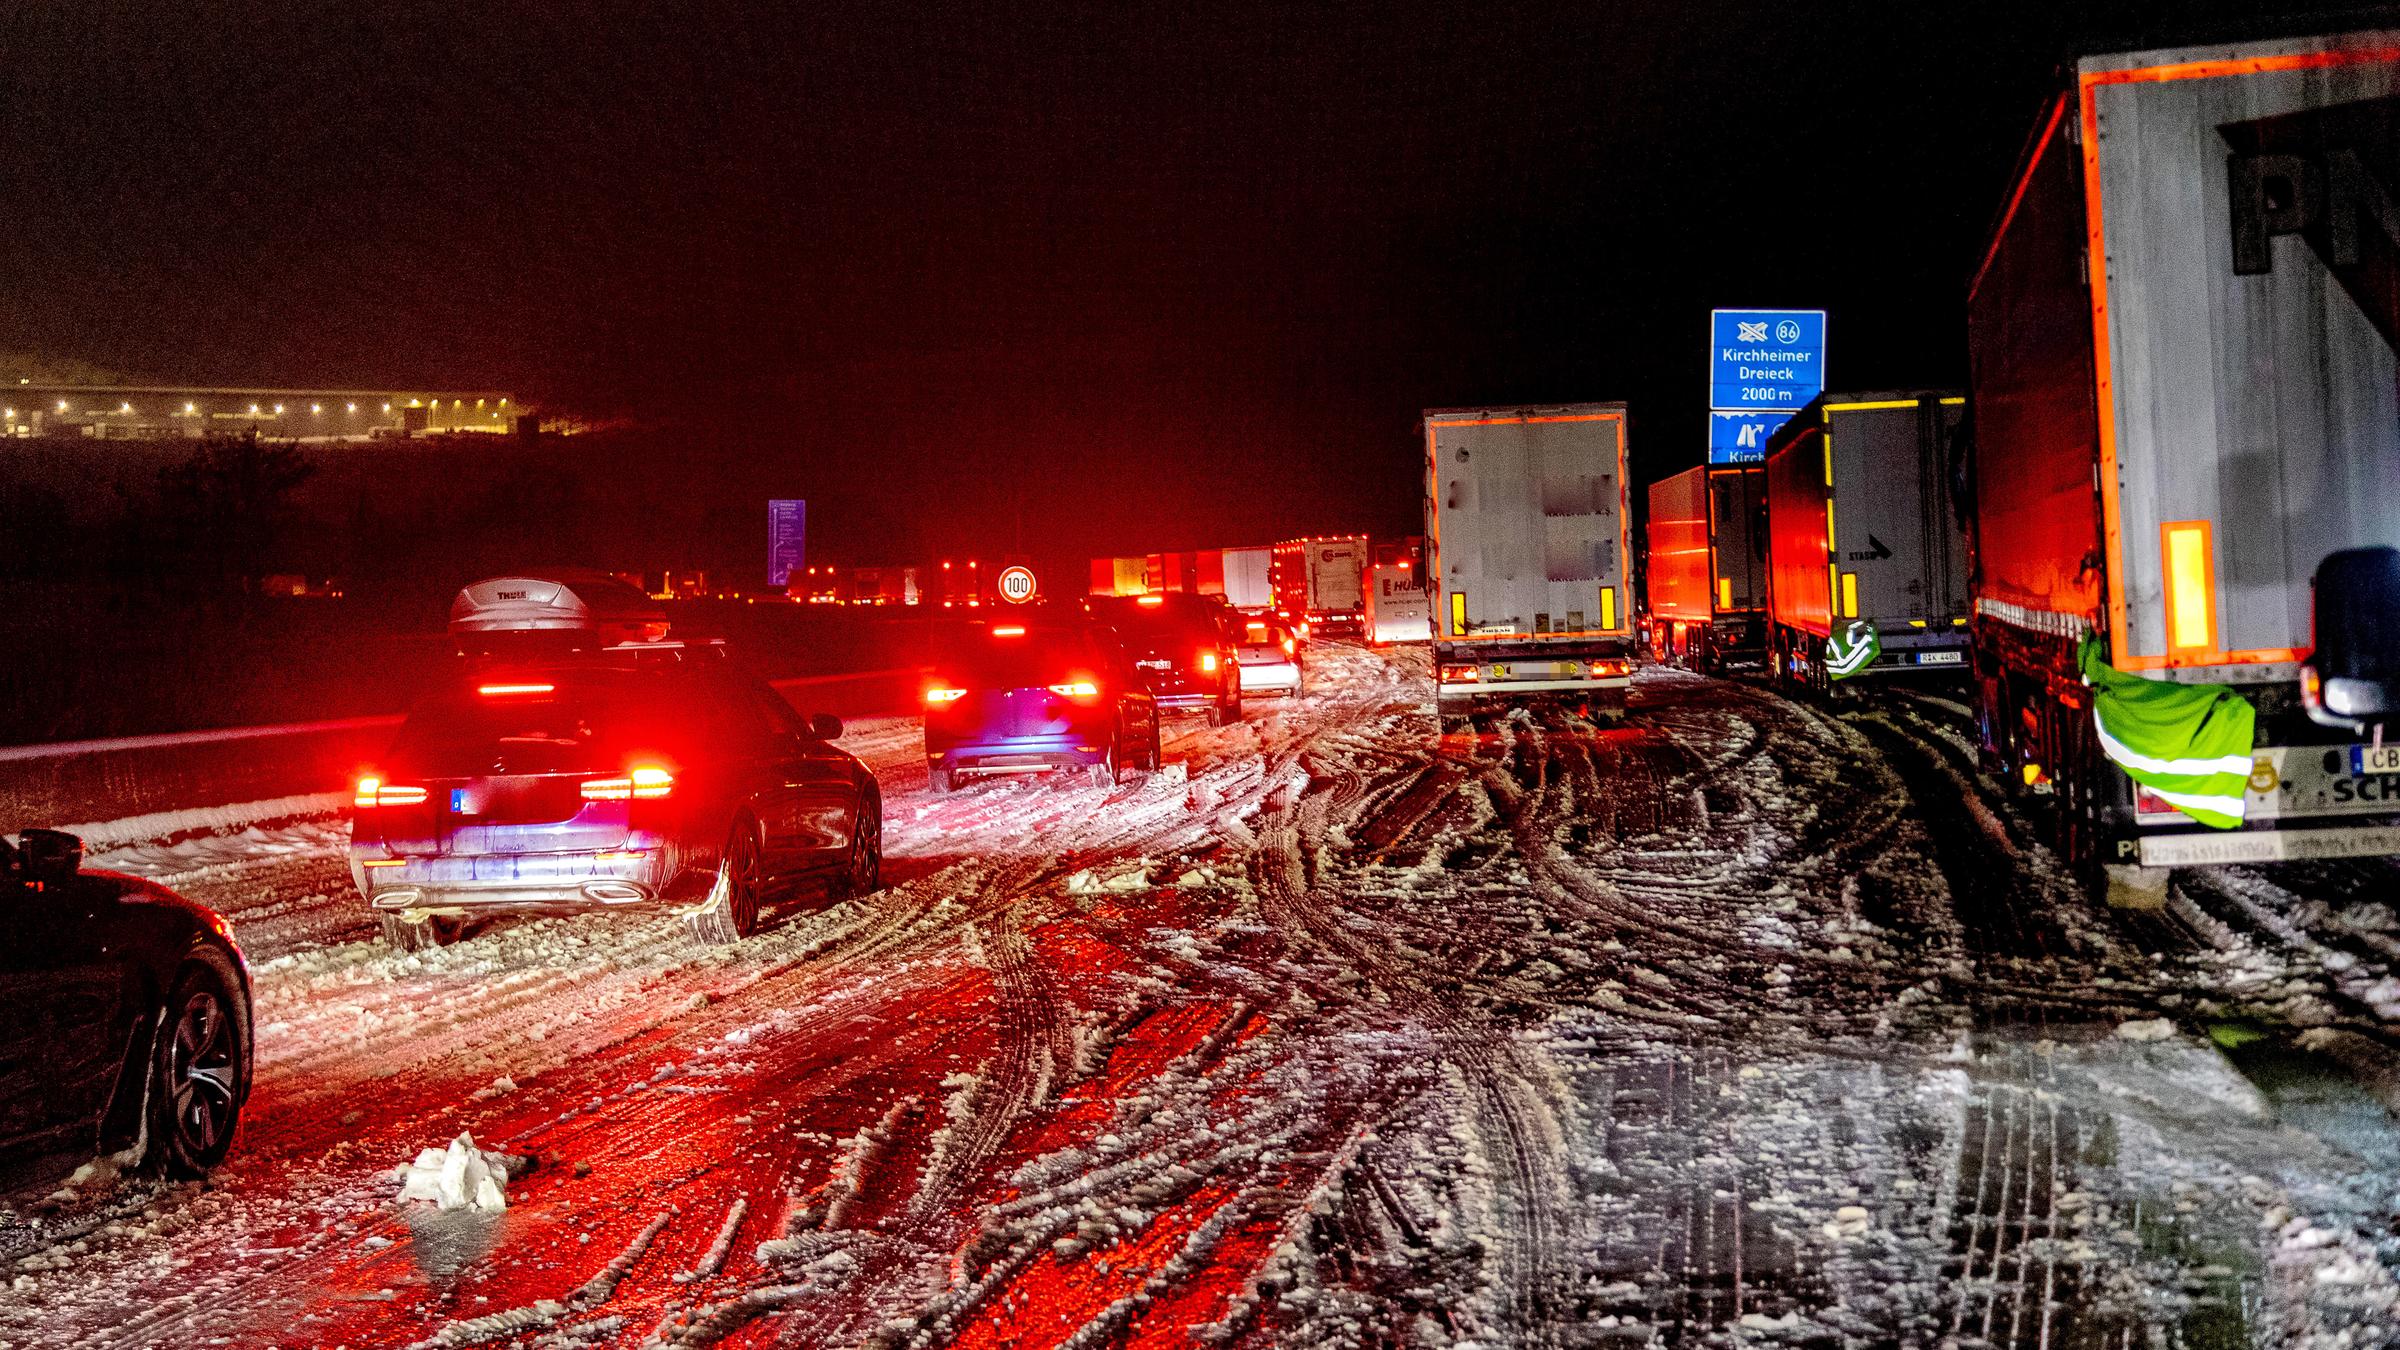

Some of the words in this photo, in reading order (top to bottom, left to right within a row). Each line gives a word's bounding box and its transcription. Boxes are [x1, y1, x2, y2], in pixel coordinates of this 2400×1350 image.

[1779, 325, 1797, 339] 86
[1722, 348, 1811, 362] Kirchheimer
[1739, 366, 1794, 380] Dreieck
[1741, 387, 1776, 401] 2000
[1778, 390, 1792, 401] m
[1007, 577, 1028, 593] 100
